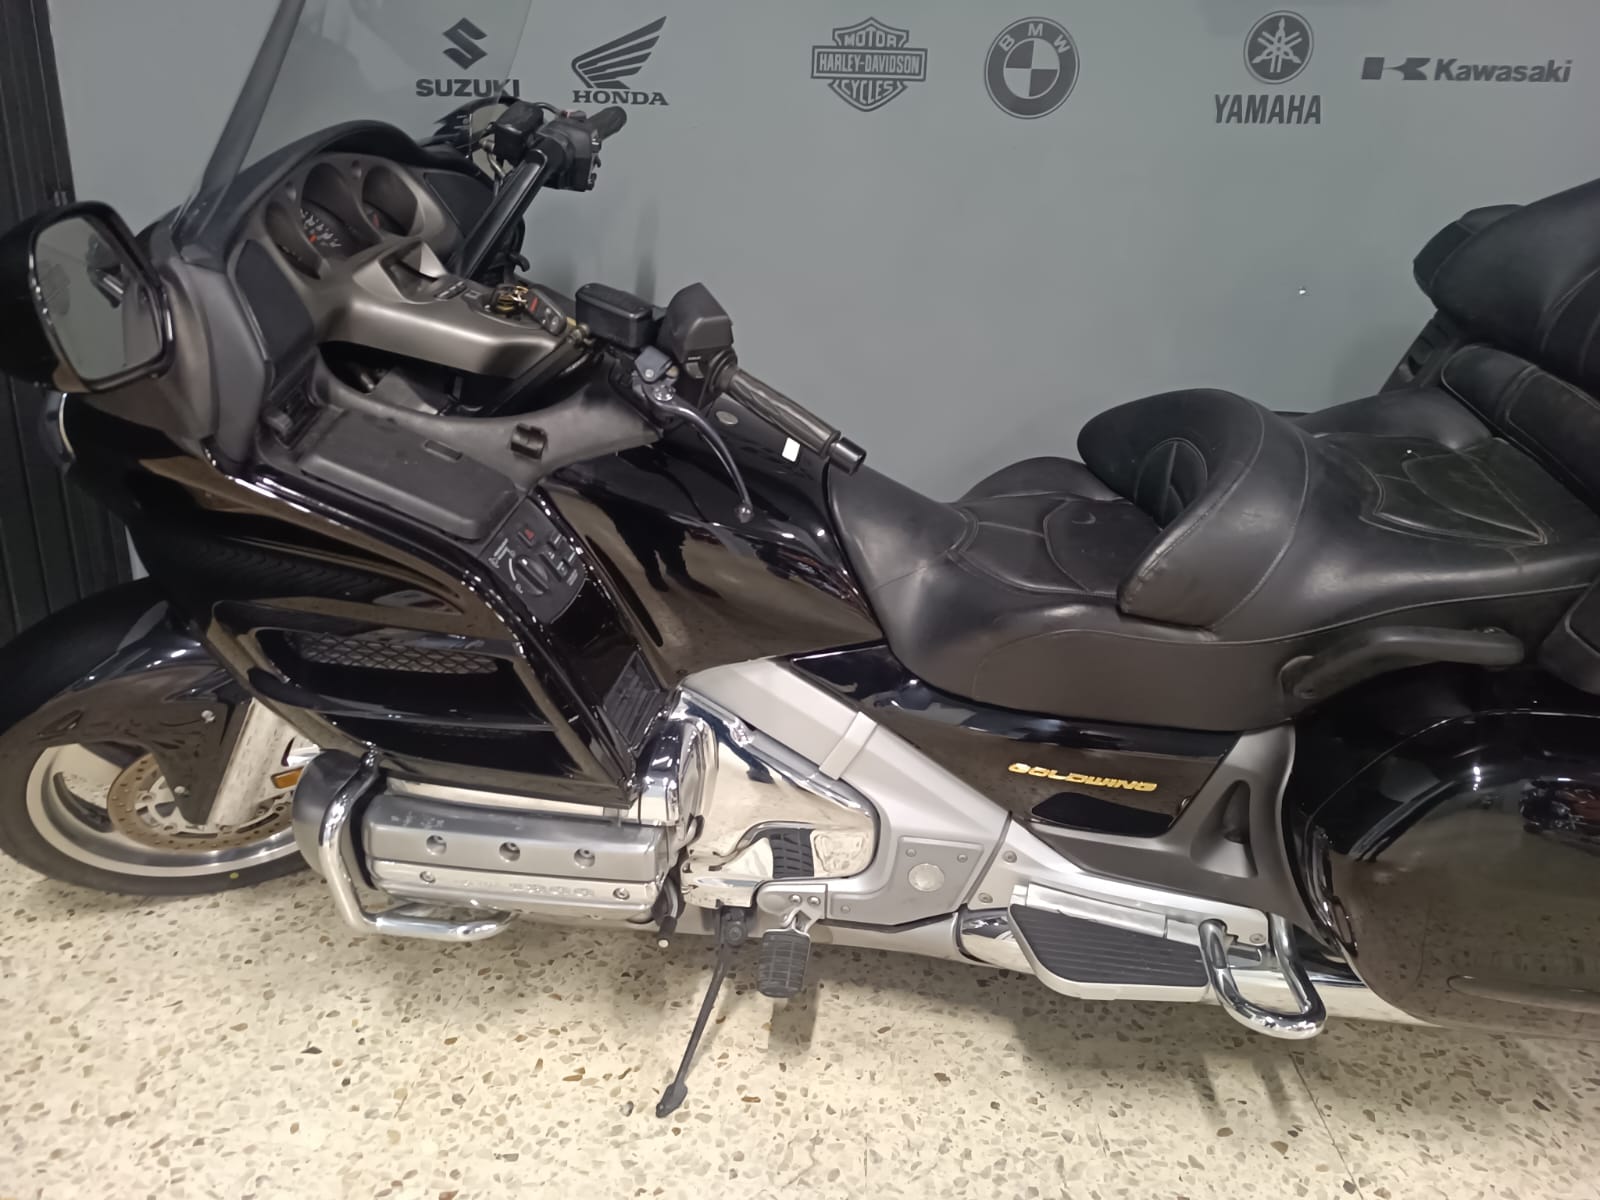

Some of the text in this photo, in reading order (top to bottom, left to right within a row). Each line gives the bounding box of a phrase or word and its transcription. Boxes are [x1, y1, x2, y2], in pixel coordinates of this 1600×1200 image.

[843, 26, 898, 48] MOTOR
[819, 52, 921, 75] HARLEY-DAVIDSON
[1433, 58, 1573, 83] Kawasaki
[415, 79, 520, 98] SUZUKI
[572, 90, 669, 106] HONDA
[841, 79, 895, 105] CYCLES
[1214, 94, 1322, 125] YAMAHA
